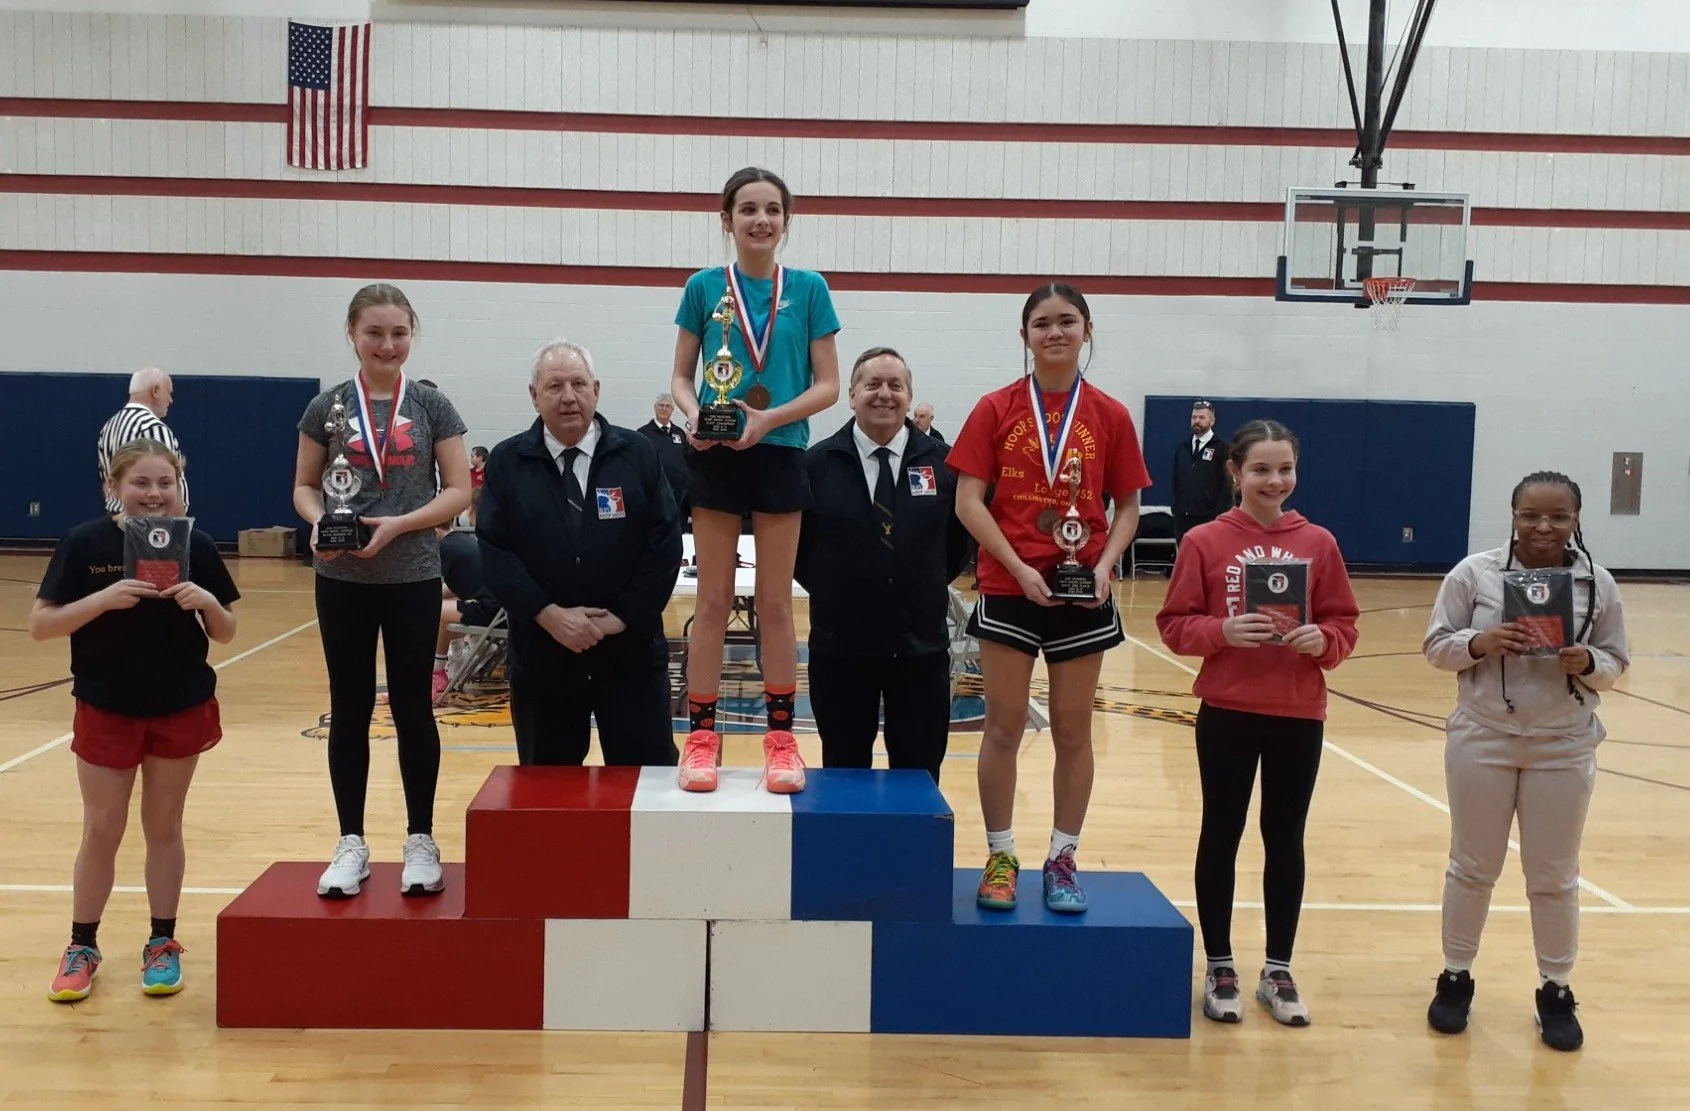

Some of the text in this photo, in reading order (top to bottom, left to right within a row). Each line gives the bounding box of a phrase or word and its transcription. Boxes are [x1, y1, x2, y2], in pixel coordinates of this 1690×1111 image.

[1001, 466, 1025, 479] Elks
[1034, 482, 1069, 498] Loge
[89, 565, 106, 574] You
[1225, 565, 1241, 593] RED
[1271, 546, 1295, 561] WH
